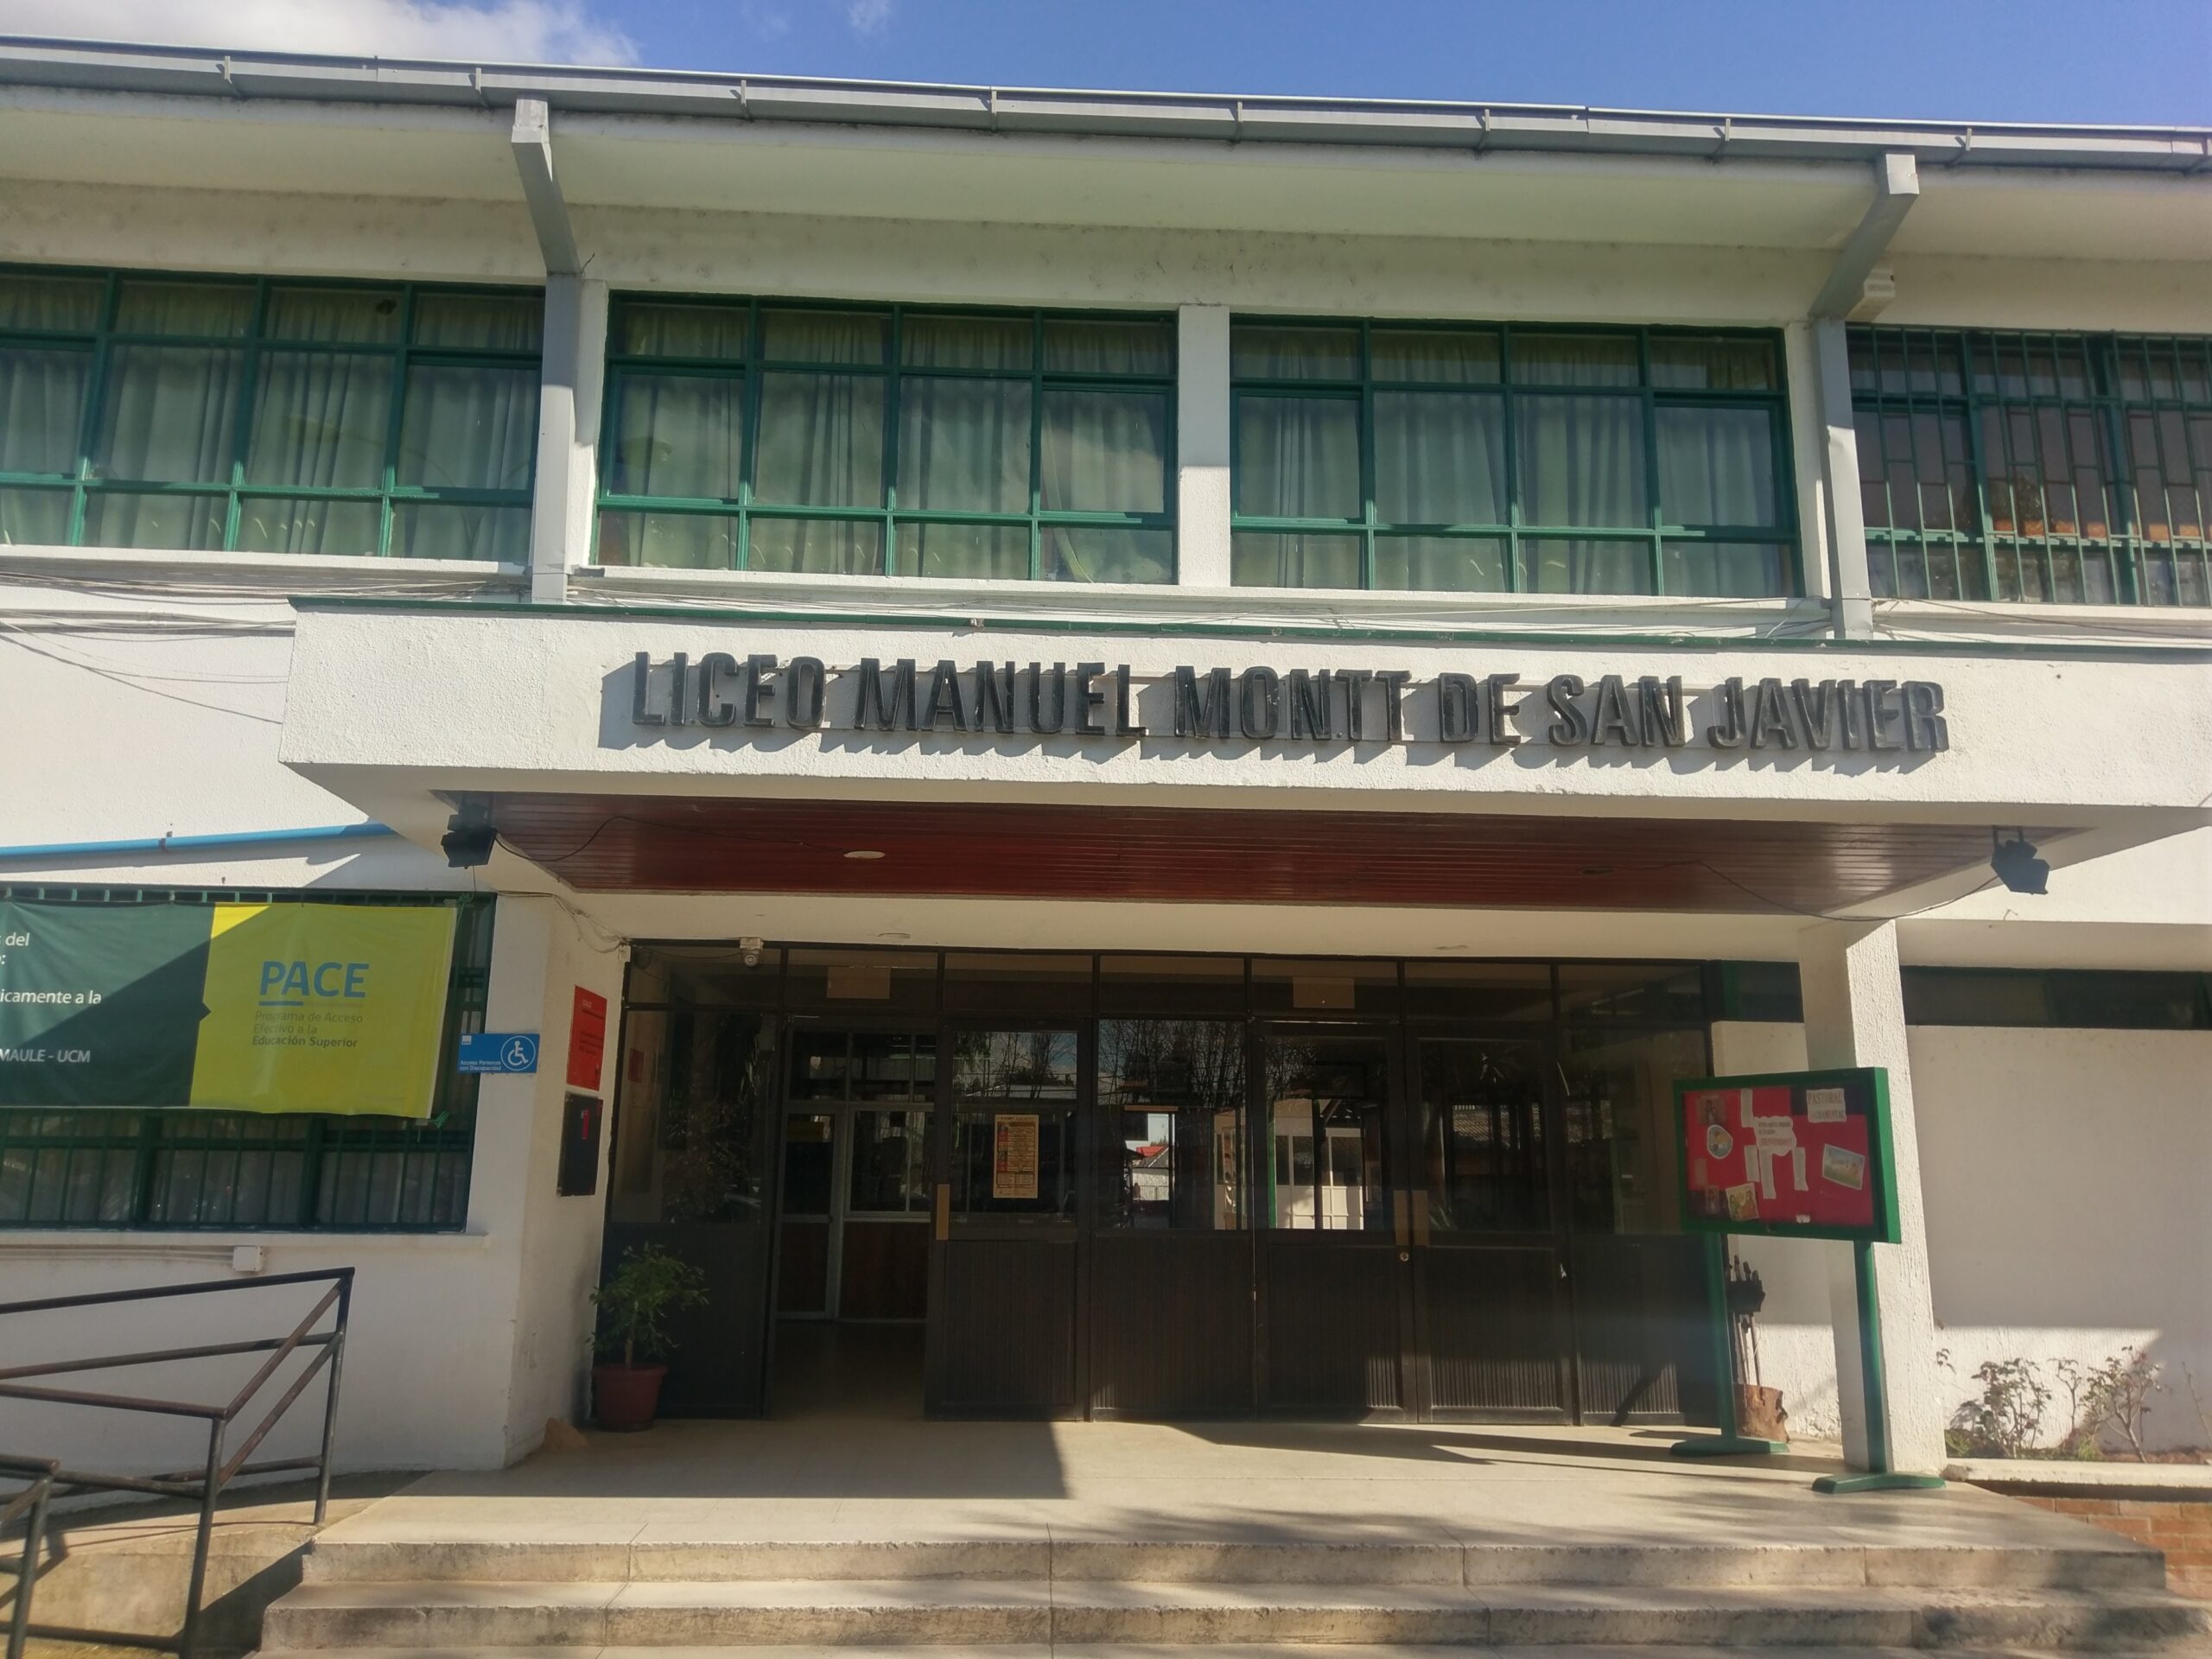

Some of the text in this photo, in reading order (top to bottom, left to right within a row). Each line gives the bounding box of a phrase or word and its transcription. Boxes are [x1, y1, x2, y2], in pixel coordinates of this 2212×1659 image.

[632, 651, 1949, 753] LICEO MANUEL MONTT DE SAN JAVIER
[5, 931, 30, 946] del
[260, 960, 370, 998] PACE
[75, 993, 84, 1004] a
[88, 990, 102, 1004] la
[255, 1010, 363, 1024] Programa de Acceso
[297, 1026, 304, 1034] a
[308, 1024, 318, 1035] la
[252, 1035, 359, 1048] Educación Superior
[0, 1048, 46, 1063] MAULE
[57, 1050, 91, 1064] UCM
